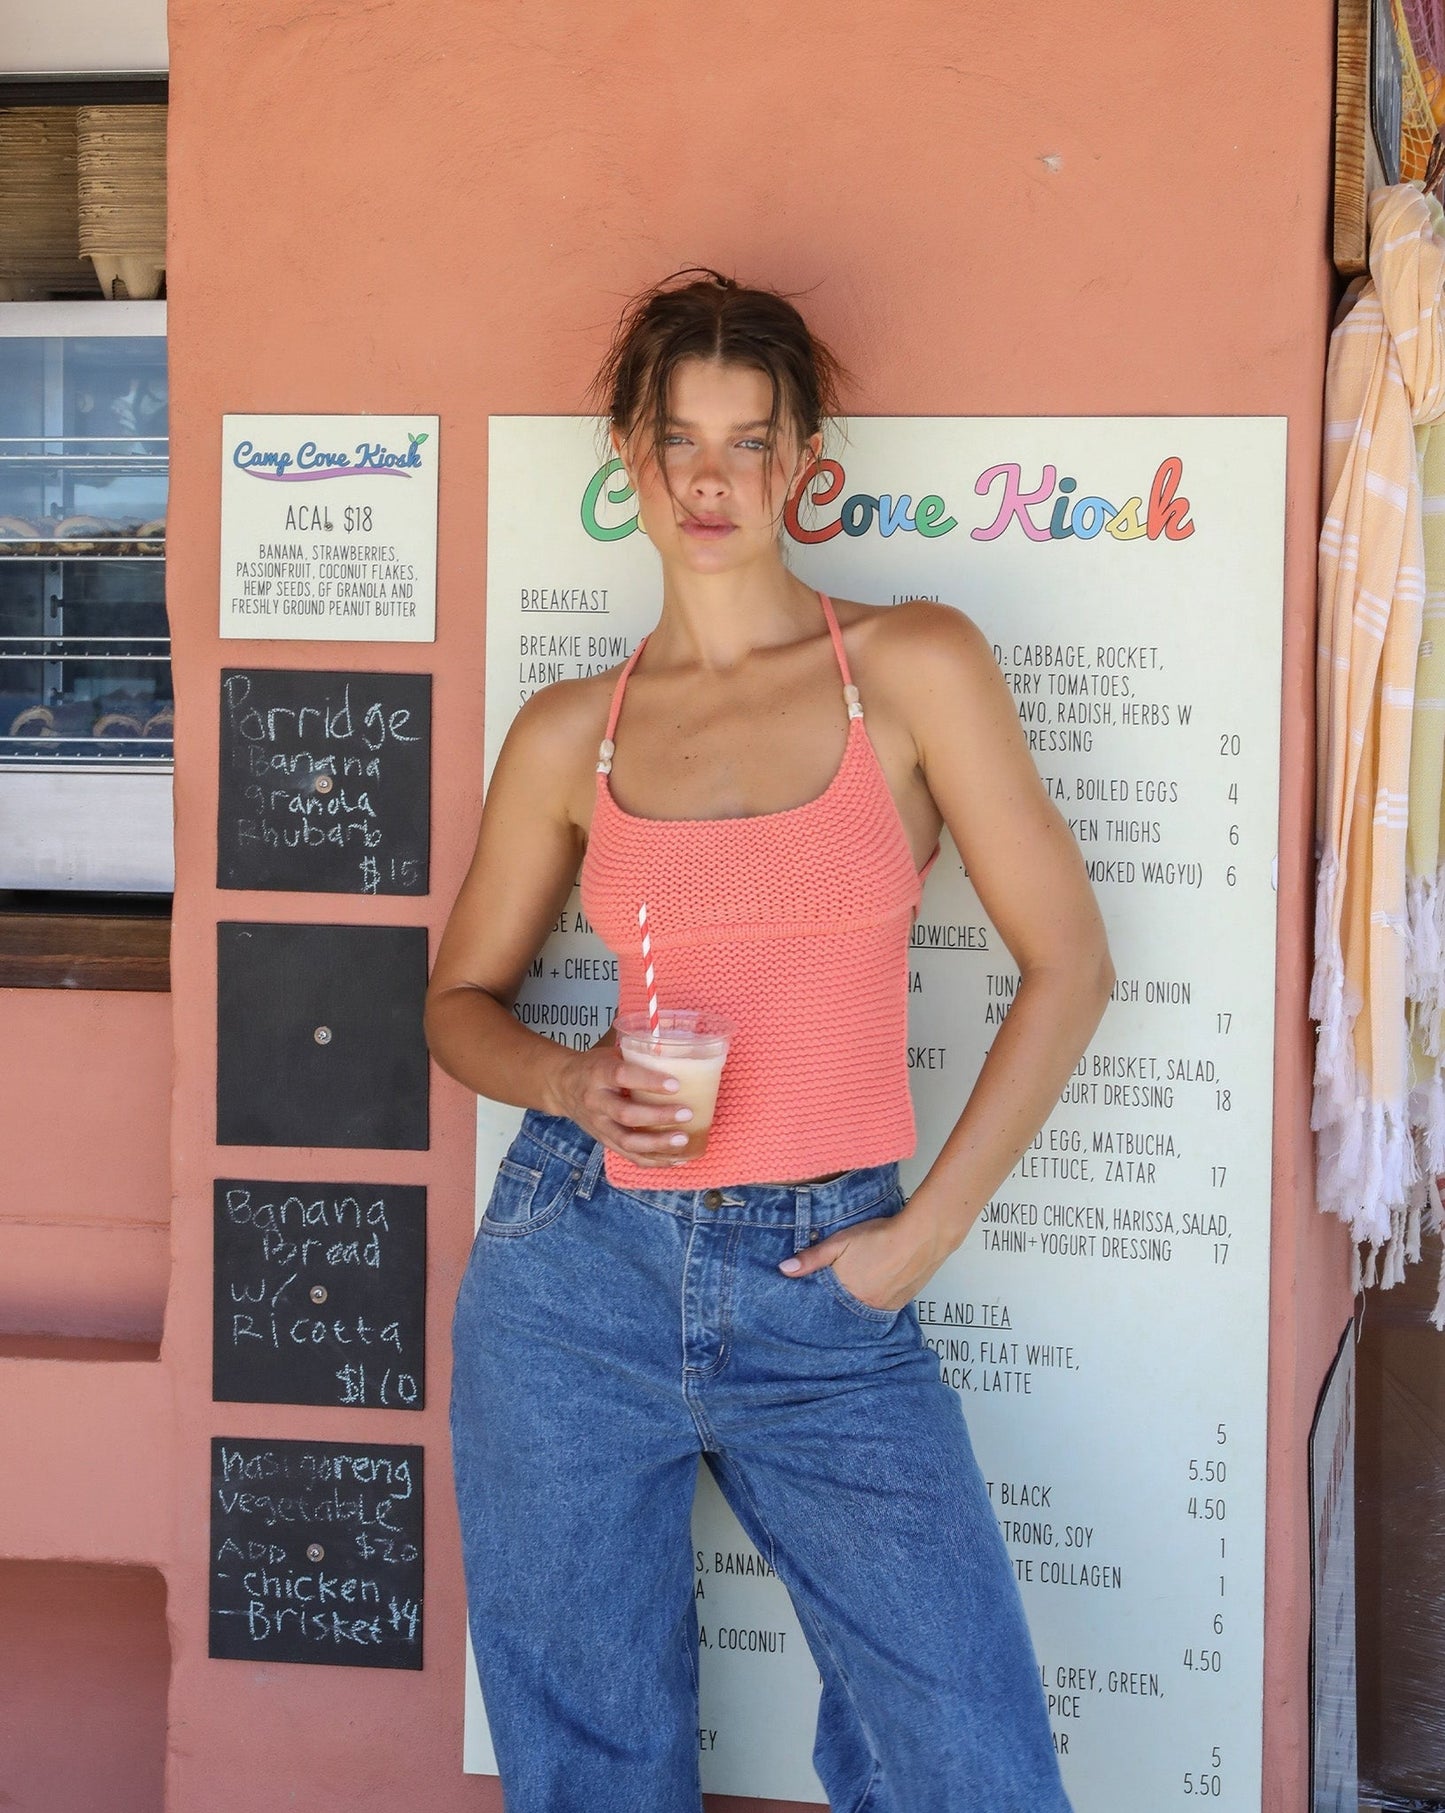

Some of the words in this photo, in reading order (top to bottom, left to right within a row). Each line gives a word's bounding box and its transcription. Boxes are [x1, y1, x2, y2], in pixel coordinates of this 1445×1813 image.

[234, 441, 292, 476] Camp
[297, 442, 350, 469] Cove
[354, 441, 421, 468] Kiosk
[784, 458, 958, 544] Cove
[971, 457, 1195, 541] Kiosk
[344, 506, 373, 533] $18
[259, 545, 307, 560] BANANA,
[312, 546, 399, 562] STRAWBERRIES,
[237, 563, 314, 580] PASSIONFRUIT,
[319, 564, 367, 579] COCONUT
[372, 565, 417, 581] FLAKES,
[244, 581, 272, 596] HEMP
[277, 581, 314, 597] SEEDS,
[318, 582, 332, 597] GF
[337, 582, 386, 598] GRANOLA
[391, 583, 413, 598] AND
[521, 589, 608, 610] BREAKFAST
[233, 599, 279, 614] FRESHLY
[283, 599, 324, 615] GROUND
[330, 600, 370, 616] PEANUT
[376, 601, 415, 617] BUTTER
[521, 636, 581, 656] BREAKIE
[1014, 645, 1091, 670] CABBAGE,
[1097, 647, 1164, 670] ROCKET,
[1049, 674, 1136, 698] TOMATOES,
[224, 675, 422, 750] Porridge
[1019, 701, 1051, 724] AVO,
[1058, 703, 1116, 726] RADISH,
[1123, 704, 1169, 725] HERBS
[1178, 705, 1191, 725] W
[1220, 735, 1240, 755] 20
[1077, 779, 1128, 801] BOILED
[1136, 781, 1177, 802] EGGS
[1229, 783, 1237, 804] 4
[1106, 821, 1160, 842] THIGHS
[1230, 825, 1239, 845] 6
[1142, 863, 1202, 888] WAGYU)
[1227, 866, 1236, 886] 6
[1146, 982, 1191, 1005] ONION
[513, 1003, 598, 1026] SOURDOUGH
[1217, 1013, 1232, 1035] 17
[1094, 1056, 1160, 1081] BRISKET,
[1167, 1059, 1220, 1084] SALAD,
[1104, 1084, 1174, 1108] DRESSING
[1216, 1090, 1231, 1111] 18
[1051, 1130, 1087, 1154] EGG,
[1093, 1132, 1181, 1159] MATBUCHA,
[1022, 1156, 1094, 1182] LETTUCE,
[1105, 1161, 1156, 1183] ZATAR
[1211, 1167, 1226, 1188] 17
[226, 1189, 388, 1232] Banana
[982, 1202, 1037, 1225] SMOKED
[1044, 1206, 1109, 1231] CHICKEN,
[1114, 1208, 1179, 1235] HARISSA,
[1182, 1213, 1232, 1238] SALAD,
[1102, 1237, 1172, 1262] DRESSING
[1214, 1244, 1228, 1265] 17
[944, 1302, 974, 1323] AND
[982, 1305, 1010, 1326] TEA
[981, 1342, 1018, 1365] FLAT
[1026, 1344, 1079, 1370] WHITE,
[984, 1370, 1031, 1393] LATTE
[1217, 1423, 1226, 1444] 5
[1188, 1459, 1225, 1482] 5.50
[1002, 1483, 1052, 1507] BLACK
[1188, 1497, 1225, 1520] 4.50
[999, 1521, 1058, 1547] TRONG,
[1065, 1526, 1093, 1548] SOY
[1041, 1562, 1121, 1589] COLLAGEN
[1213, 1614, 1223, 1634] 6
[719, 1628, 786, 1653] COCONUT
[1184, 1649, 1221, 1672] 4.50
[1057, 1667, 1102, 1693] GREY,
[1108, 1671, 1164, 1698] GREEN,
[1212, 1747, 1221, 1767] 5
[1184, 1773, 1221, 1796] 5.50
